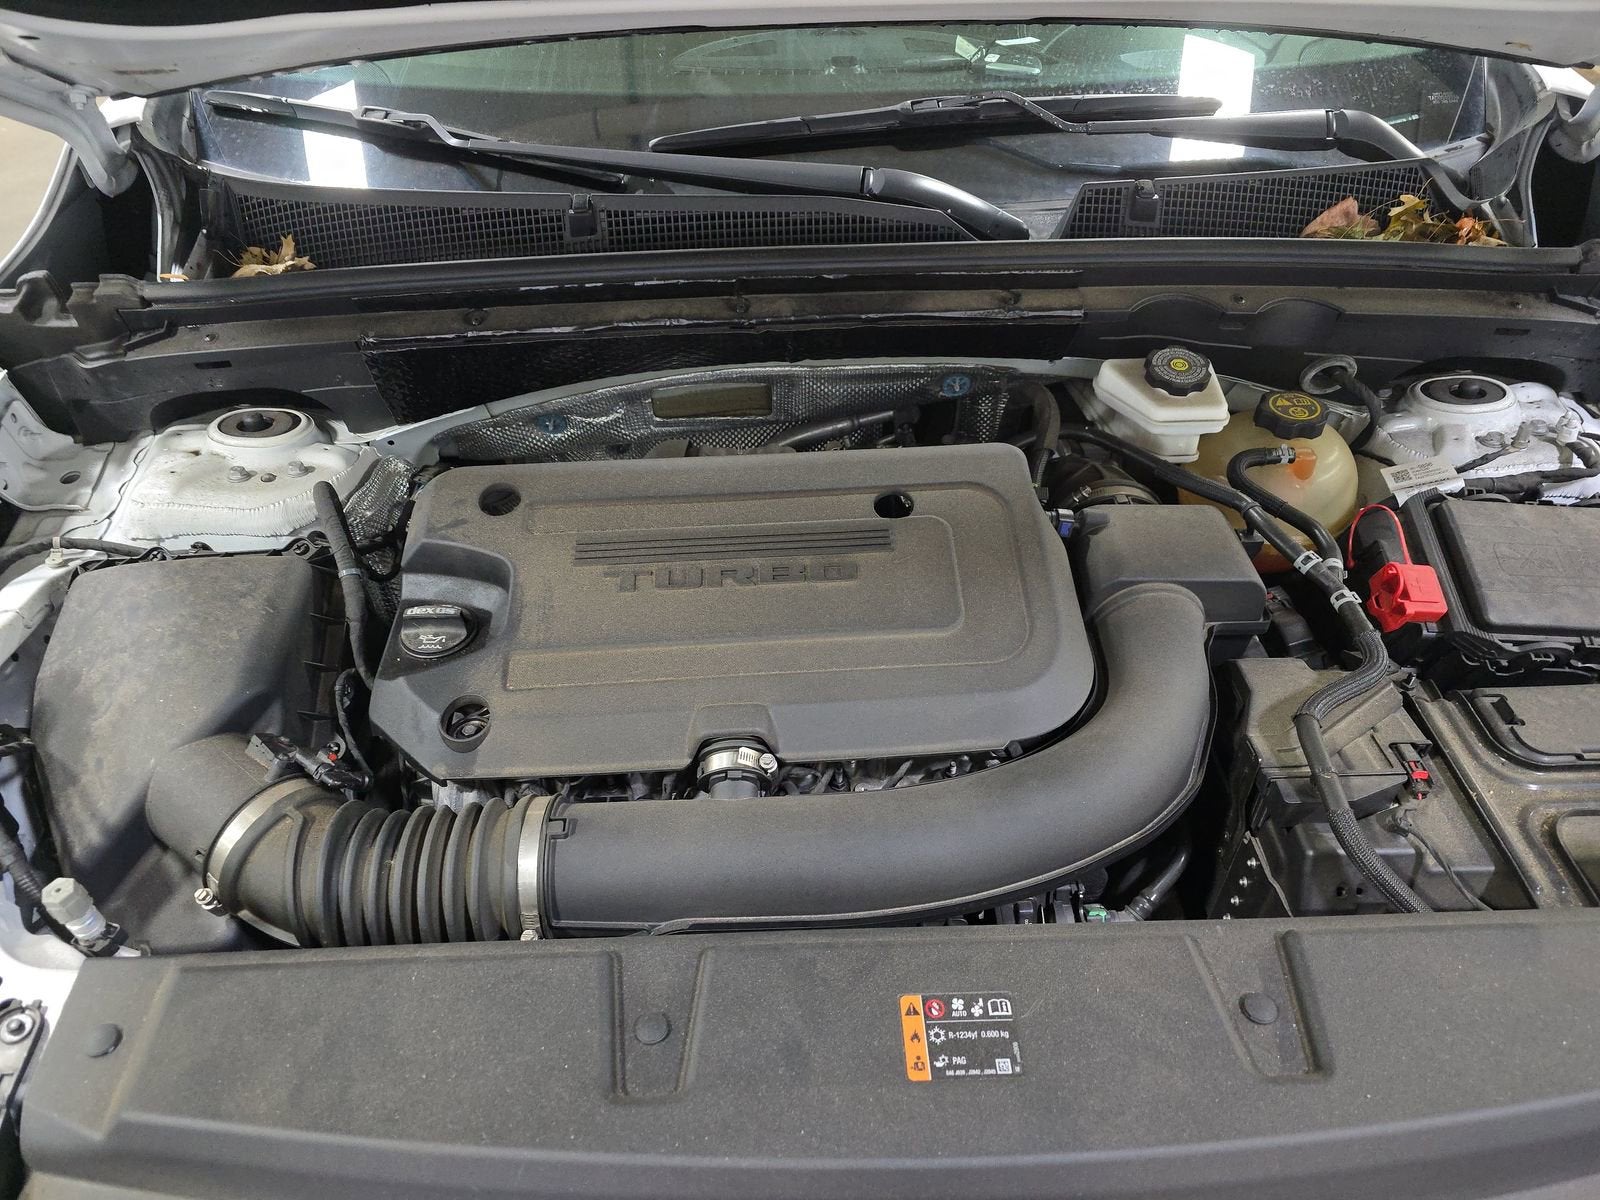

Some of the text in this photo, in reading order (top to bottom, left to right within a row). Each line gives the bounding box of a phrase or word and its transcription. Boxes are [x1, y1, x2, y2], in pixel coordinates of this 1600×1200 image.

[603, 562, 858, 592] TURBO
[981, 1030, 999, 1038] 0.600
[1000, 1030, 1009, 1039] kg
[952, 1056, 967, 1065] PAG
